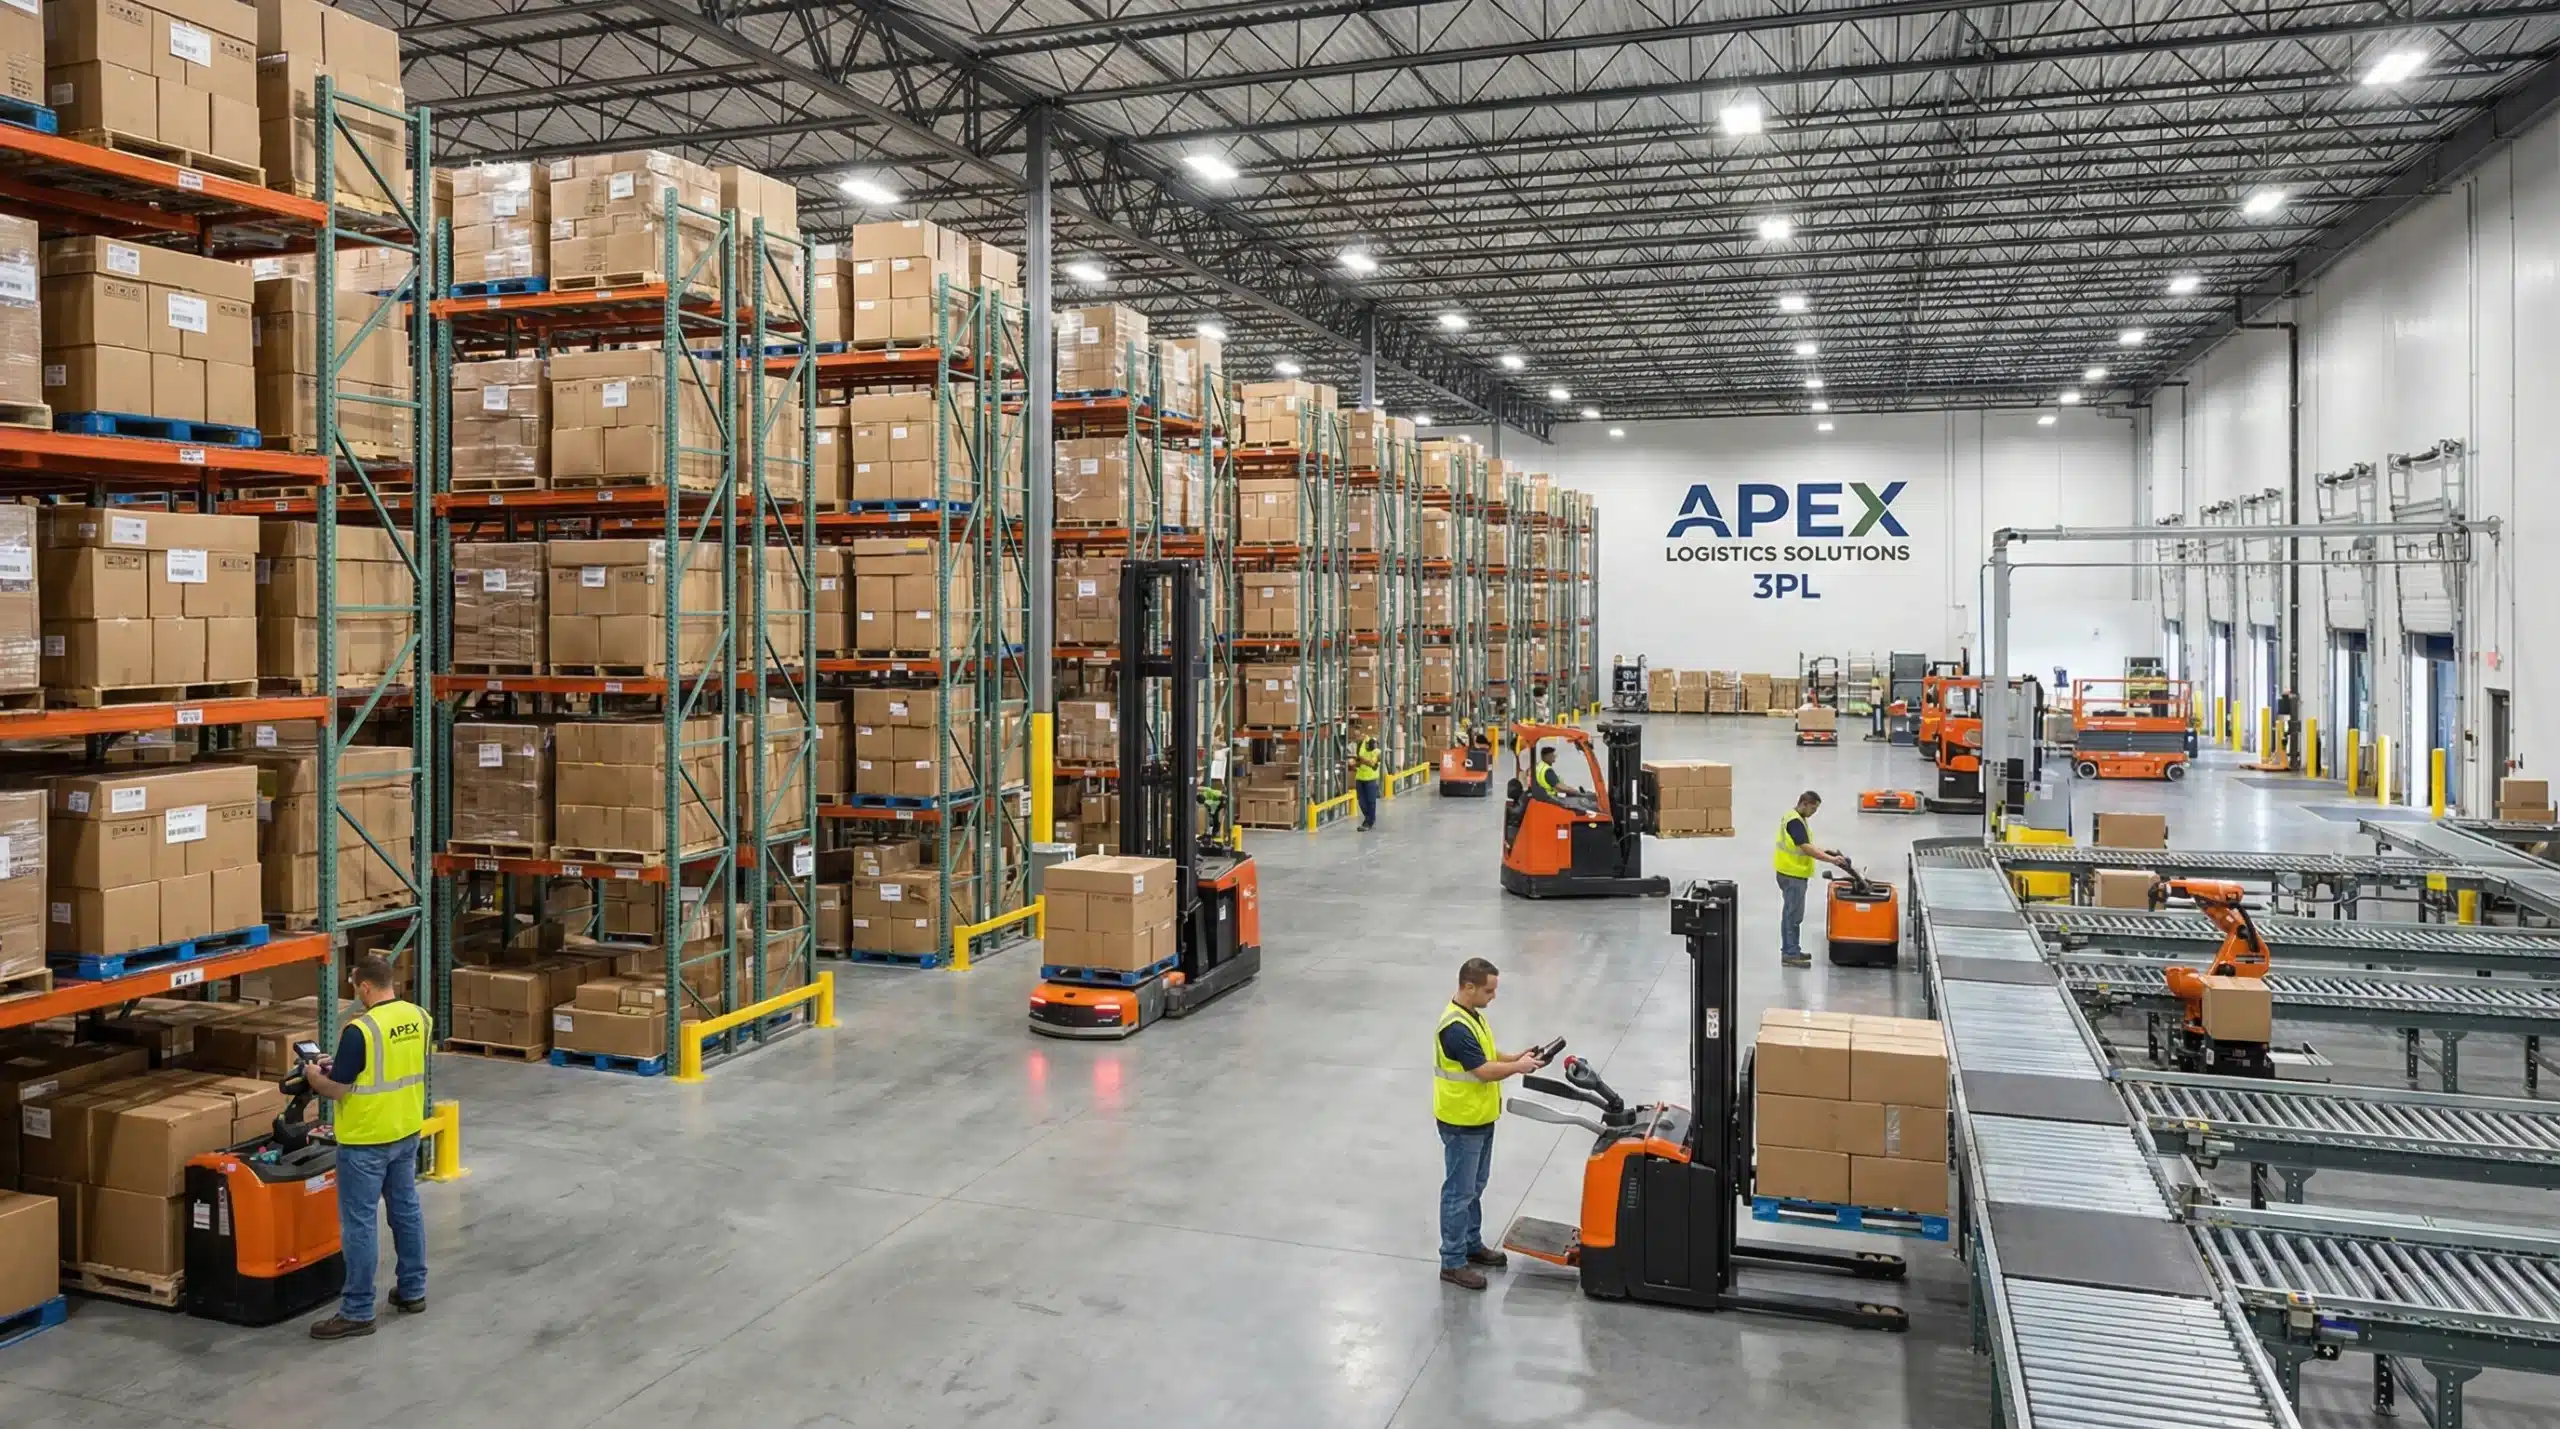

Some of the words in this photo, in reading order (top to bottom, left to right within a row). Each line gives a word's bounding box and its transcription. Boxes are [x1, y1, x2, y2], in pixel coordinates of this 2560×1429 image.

[1666, 481, 1910, 538] APEX
[1666, 545, 1777, 562] LOGISTICS
[1783, 545, 1910, 562] SOLUTIONS
[1753, 573, 1821, 599] 3PL
[389, 1022, 420, 1039] APEX
